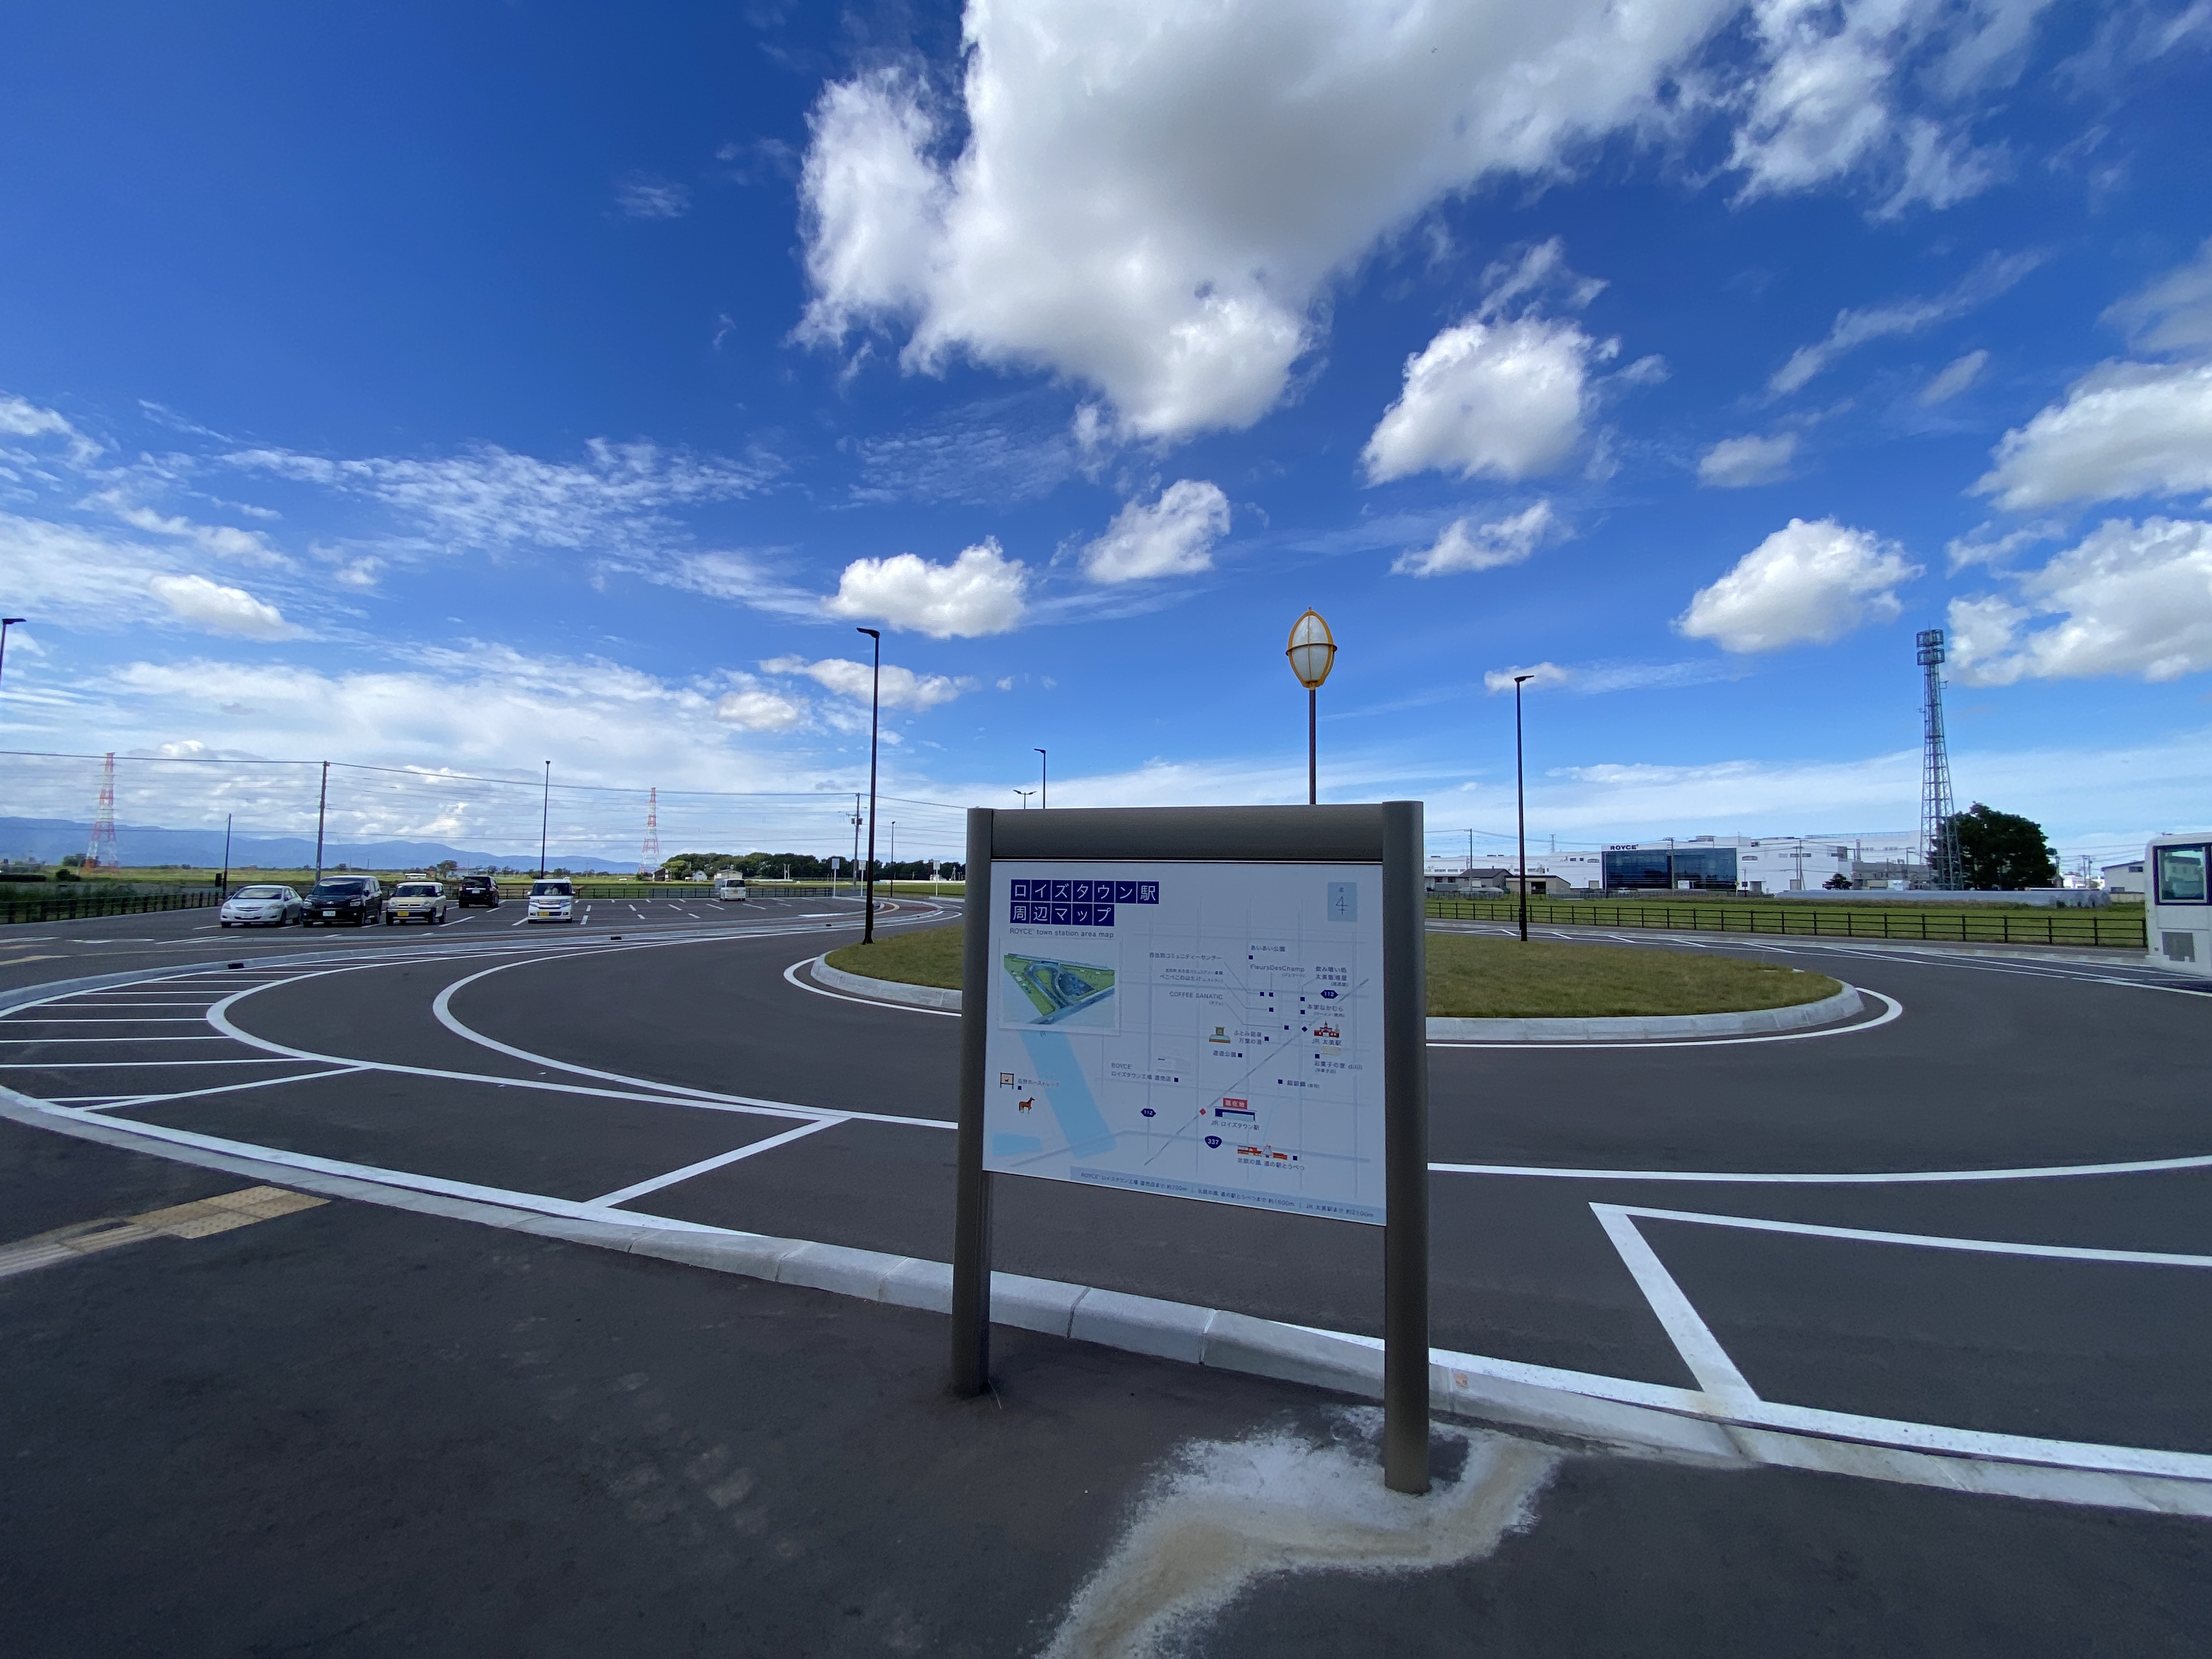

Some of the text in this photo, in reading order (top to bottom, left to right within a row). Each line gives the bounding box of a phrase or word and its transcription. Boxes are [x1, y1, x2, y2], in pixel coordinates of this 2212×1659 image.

[1014, 883, 1156, 901] ロイズタウン駅
[1013, 906, 1111, 922] 周辺マップ
[1111, 1071, 1152, 1080] ロイズタウン工場
[1225, 1099, 1245, 1108] 現在地
[1221, 1121, 1260, 1130] ロイズタウン駅
[1264, 1161, 1305, 1170] 道の駅とうべつ
